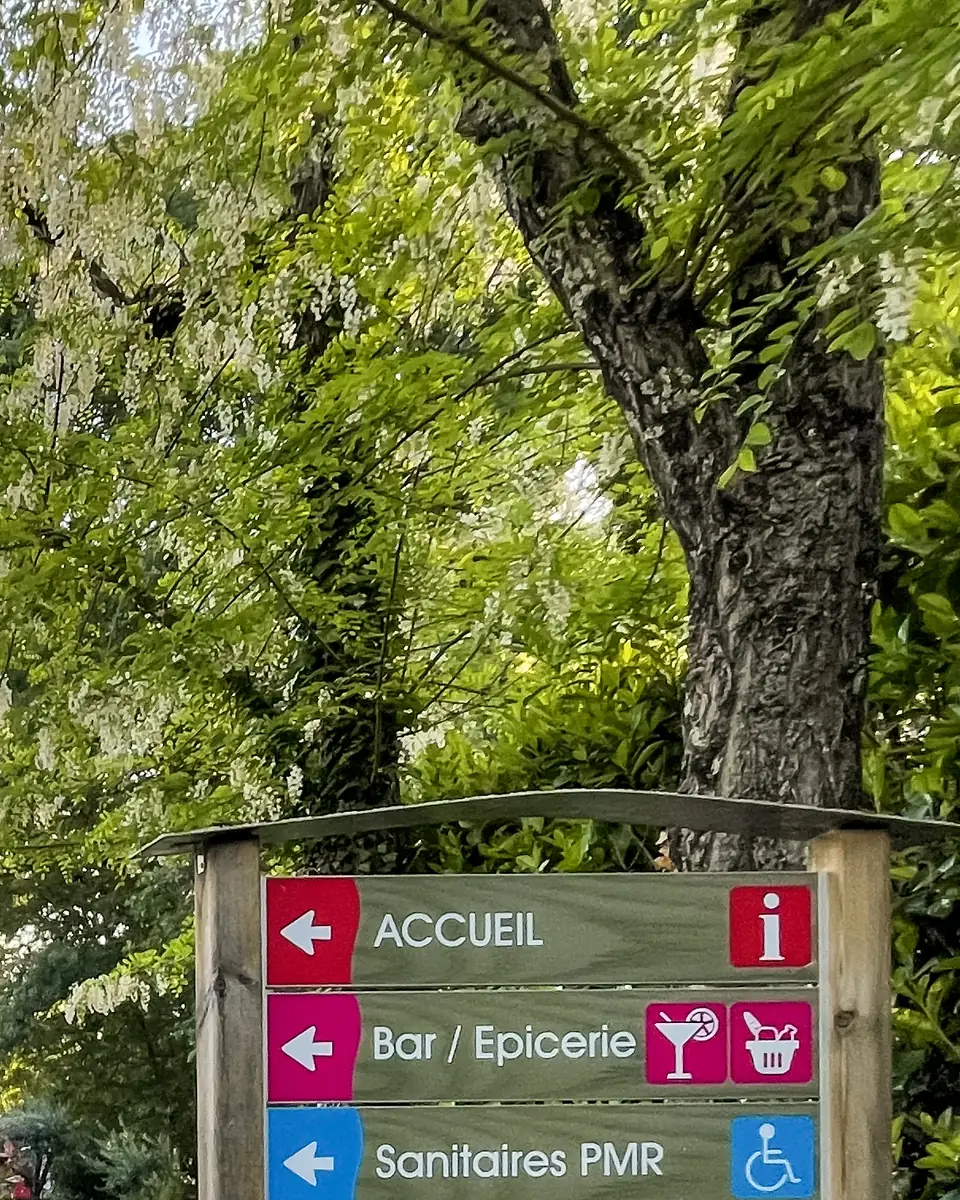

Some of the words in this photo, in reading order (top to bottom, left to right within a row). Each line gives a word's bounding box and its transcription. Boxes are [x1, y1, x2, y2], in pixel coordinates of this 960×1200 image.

[373, 912, 544, 948] ACCUEIL
[373, 1026, 437, 1060] Bar
[447, 1024, 462, 1064] /
[475, 1024, 637, 1067] Epicerie
[375, 1143, 567, 1179] Sanitaires
[580, 1141, 664, 1177] PMR
